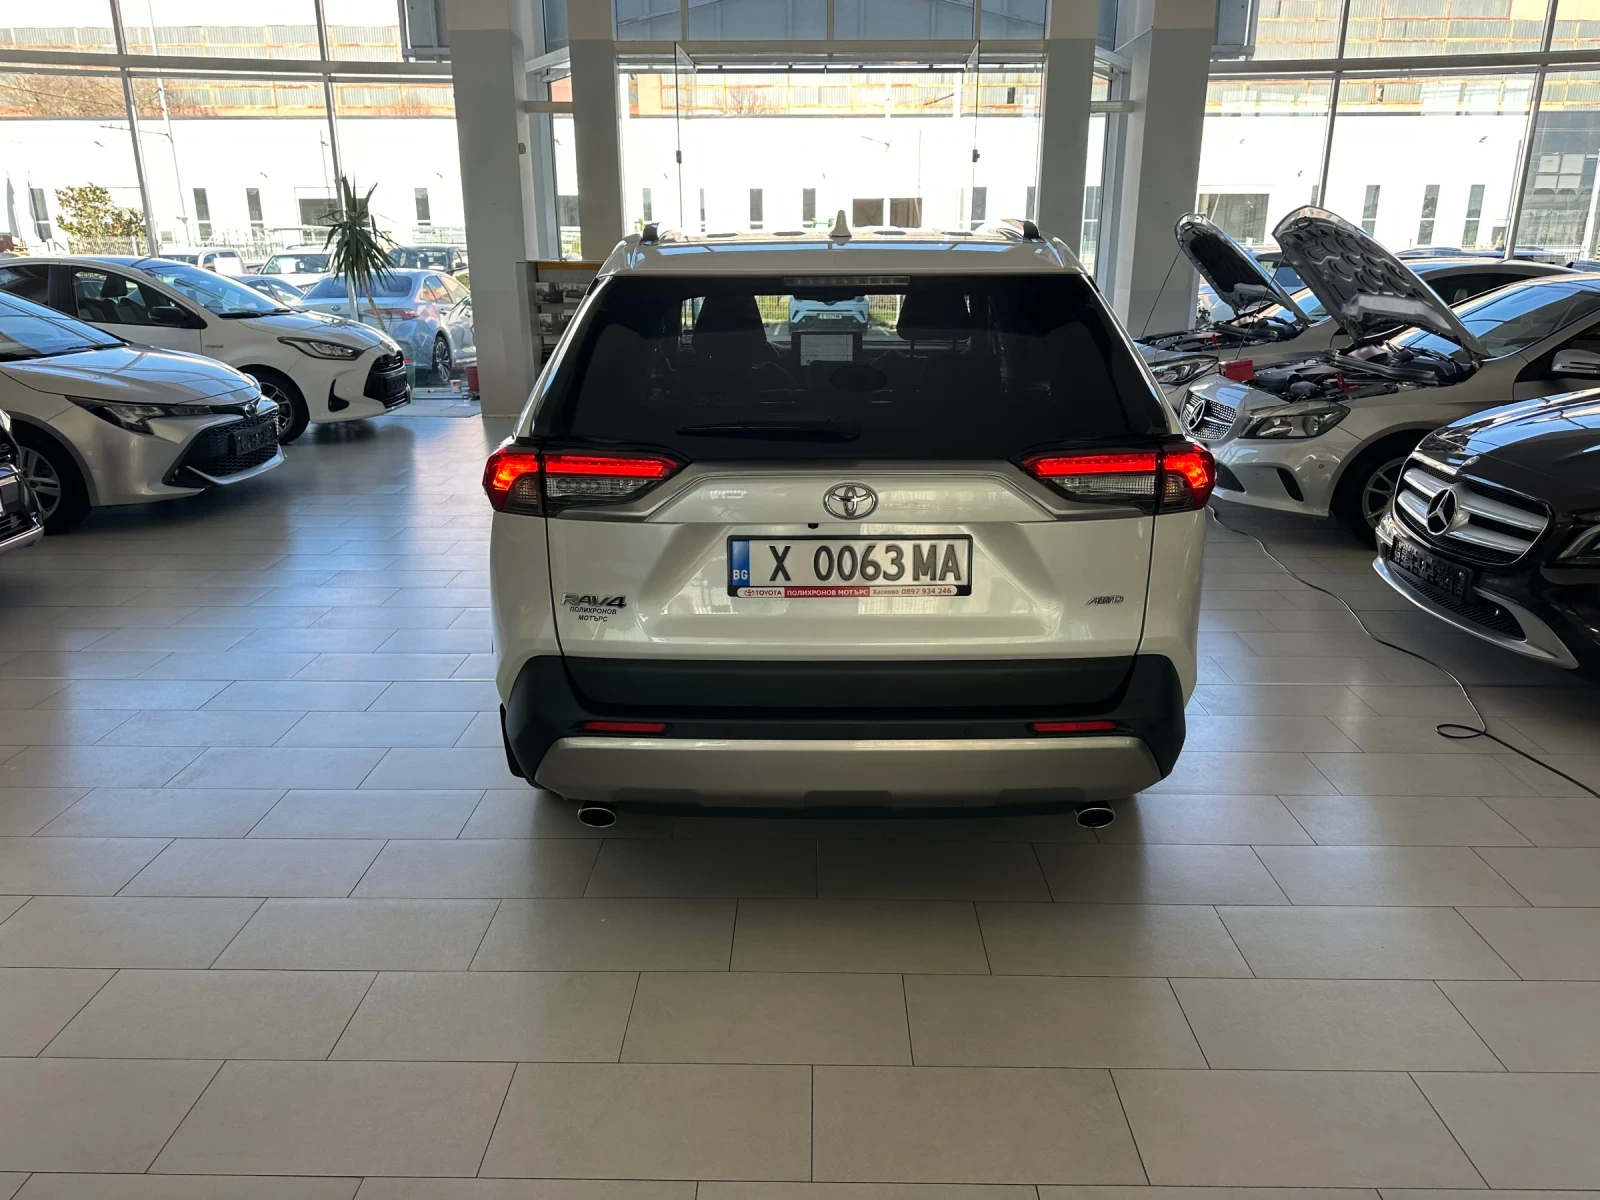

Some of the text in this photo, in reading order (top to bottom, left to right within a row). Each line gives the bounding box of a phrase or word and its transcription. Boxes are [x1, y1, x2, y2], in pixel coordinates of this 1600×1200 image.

[732, 569, 748, 580] BG
[786, 589, 837, 597] ПОЛИХРОНОВ
[838, 588, 869, 596] МОТЪРС
[921, 587, 936, 595] 934
[937, 587, 952, 595] 246
[561, 593, 627, 608] RAV4
[1085, 595, 1125, 606] AWD
[569, 606, 617, 615] ПОЛИХРОНОВ
